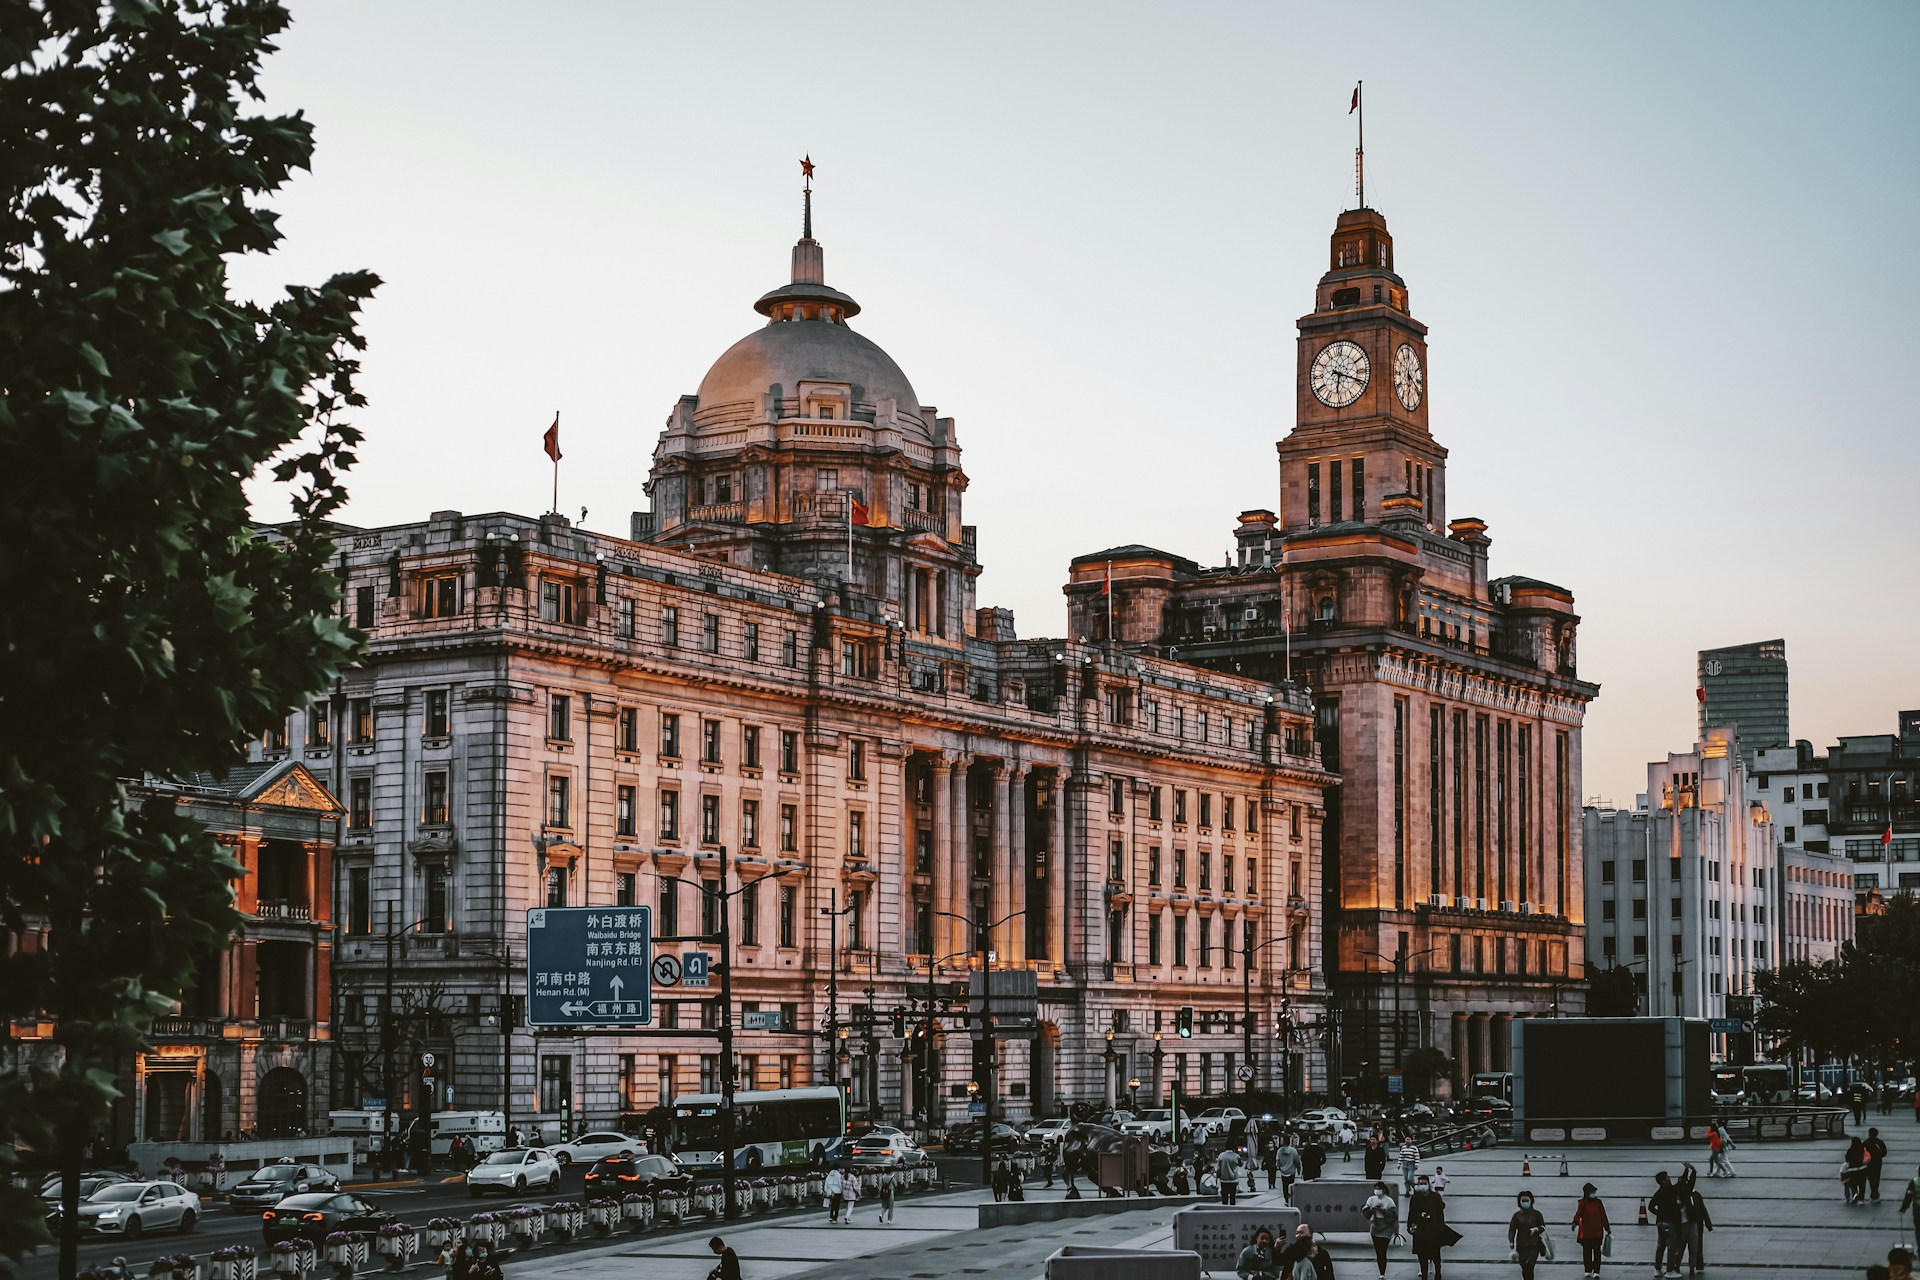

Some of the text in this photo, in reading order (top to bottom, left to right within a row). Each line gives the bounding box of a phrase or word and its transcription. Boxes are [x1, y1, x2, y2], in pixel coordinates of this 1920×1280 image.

[535, 912, 543, 921] 北
[586, 913, 642, 928] 外白渡桥
[587, 930, 642, 940] Waibaidu Bridge
[586, 941, 642, 956] 南京东路
[586, 958, 616, 969] Nanjing
[535, 971, 591, 986] 河南中路
[536, 988, 562, 996] Henan
[597, 1003, 637, 1014] 福州路
